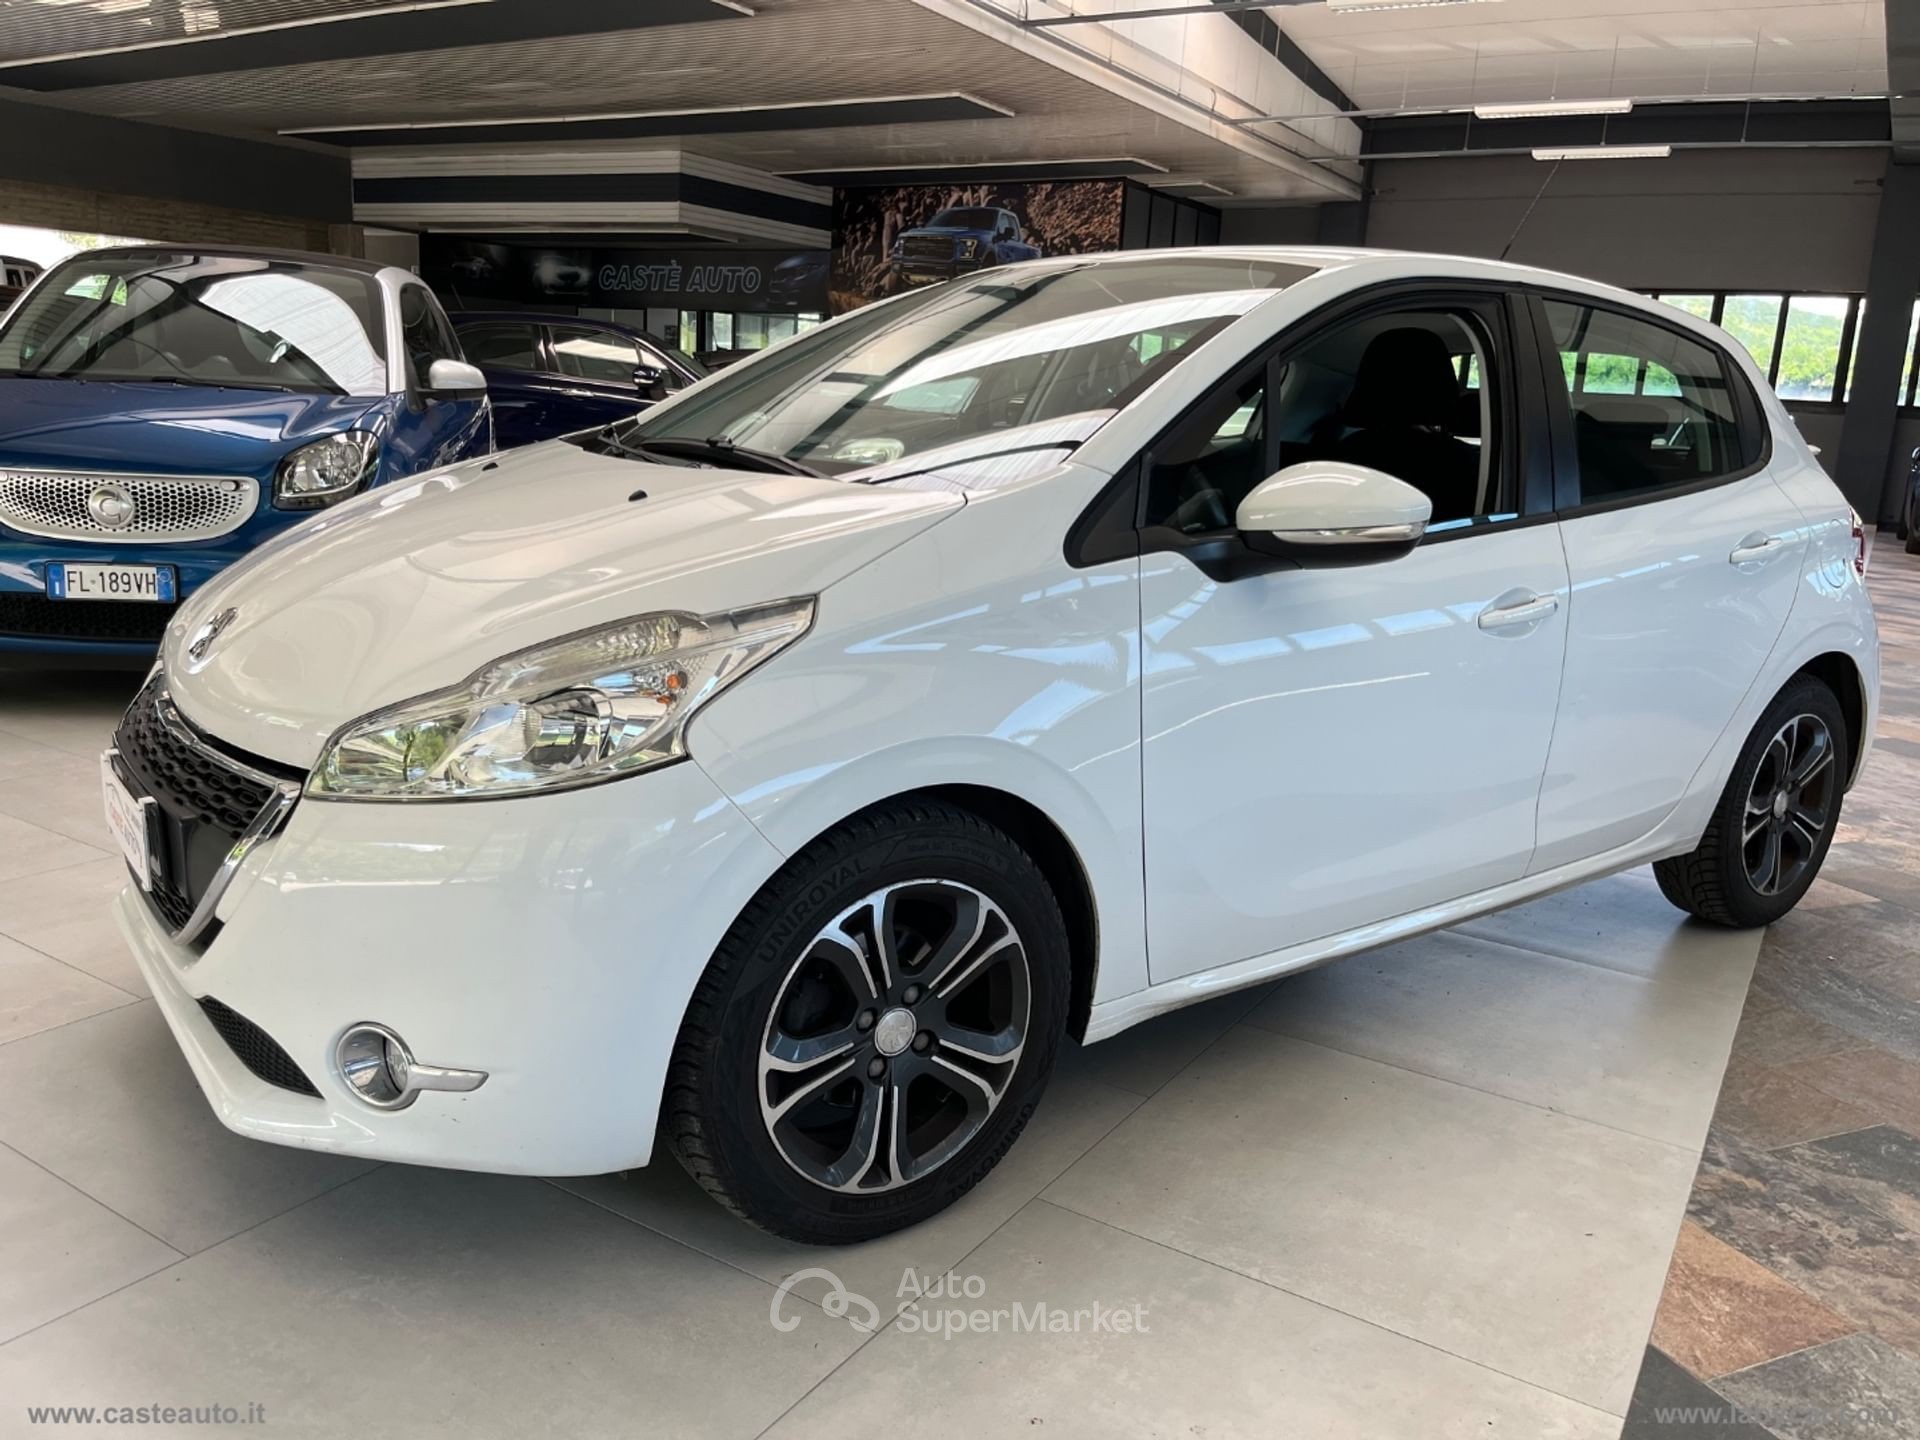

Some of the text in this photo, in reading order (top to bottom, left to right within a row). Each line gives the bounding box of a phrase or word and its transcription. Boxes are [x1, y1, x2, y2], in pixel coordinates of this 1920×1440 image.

[599, 259, 762, 294] CASTÈ AUTO
[757, 857, 870, 963] UNIROYAL
